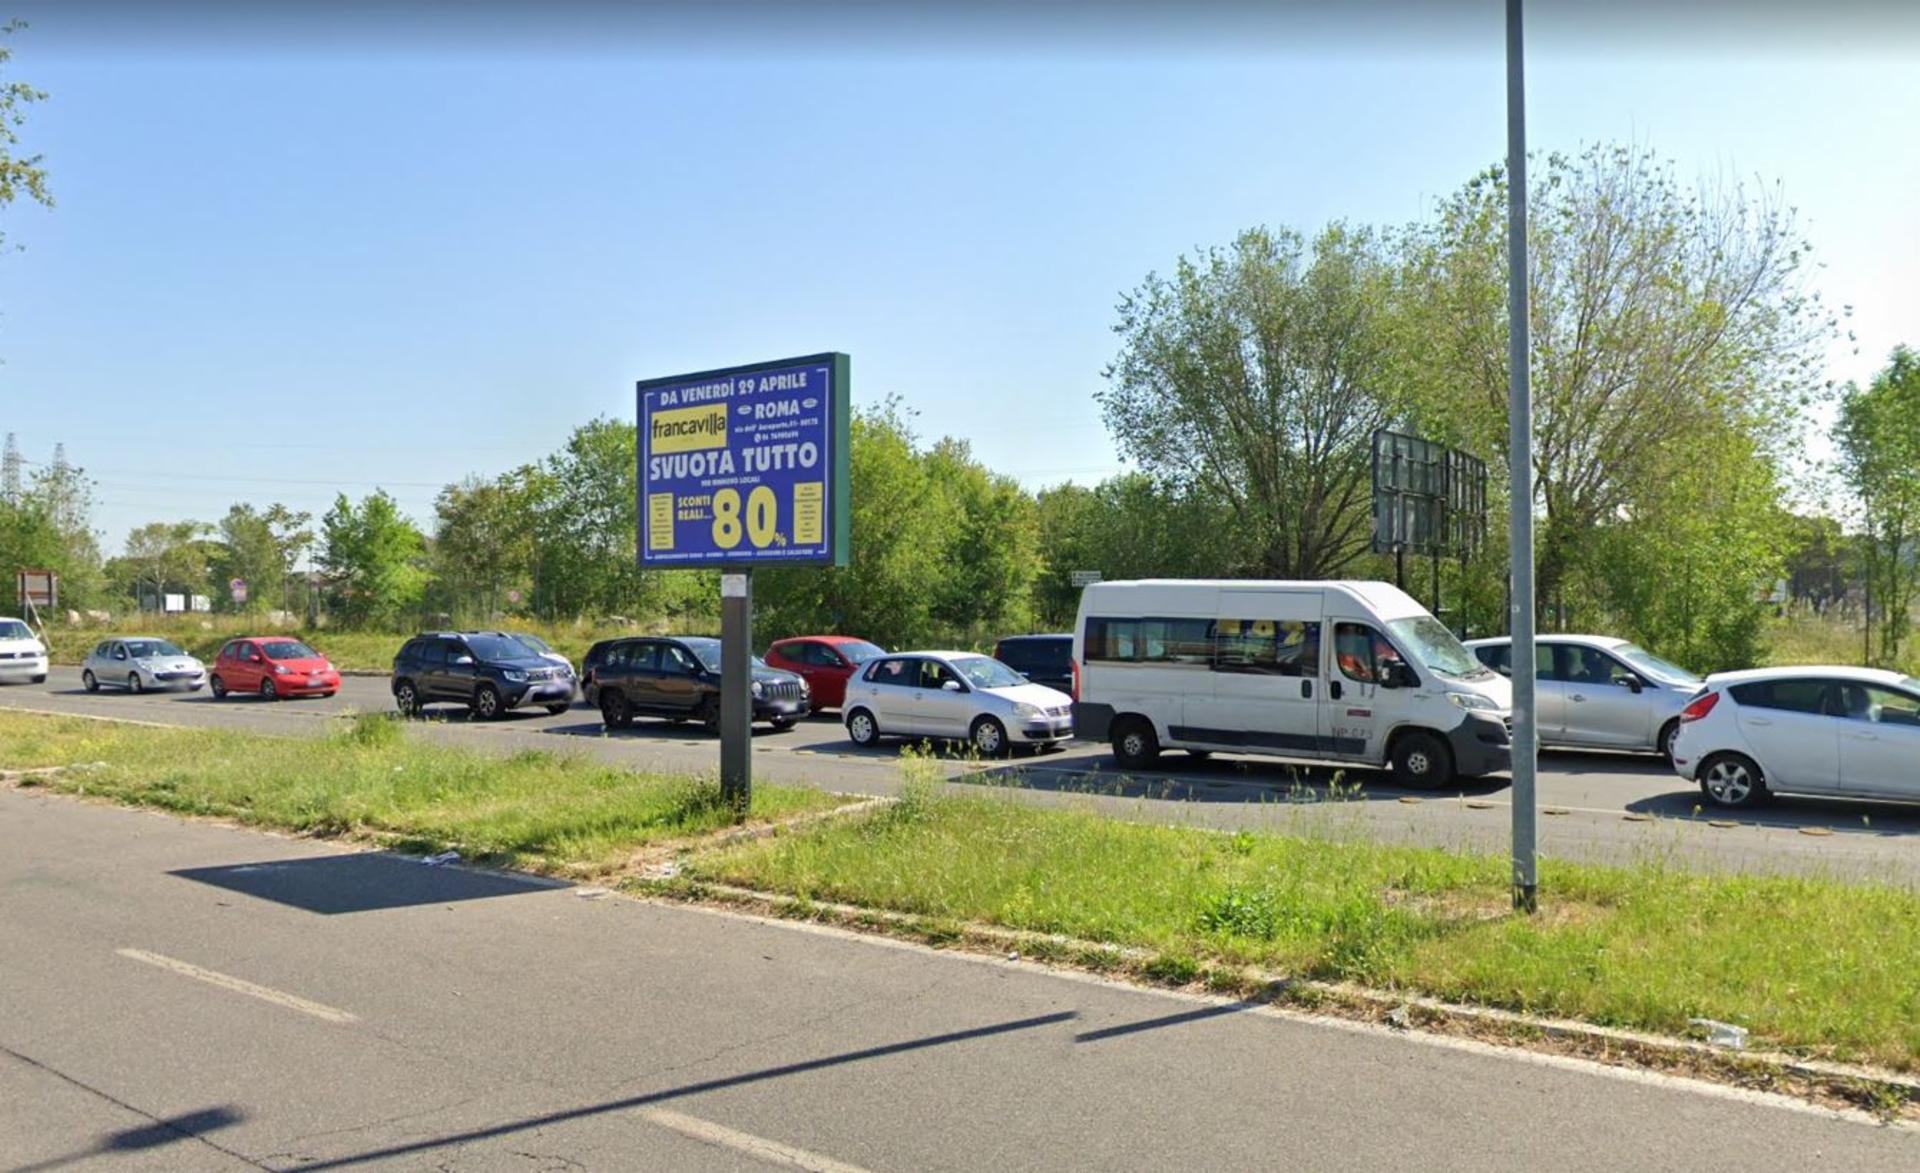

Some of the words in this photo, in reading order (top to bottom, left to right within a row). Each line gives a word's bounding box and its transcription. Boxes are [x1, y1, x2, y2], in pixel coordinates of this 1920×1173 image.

[660, 392, 678, 406] DA
[681, 378, 734, 402] VENERDÌ
[738, 379, 755, 395] 29
[759, 372, 807, 393] APRILE
[754, 398, 800, 420] ROMA
[652, 412, 726, 440] francavilla
[649, 449, 735, 481] SVUOTA
[742, 441, 818, 472] TUTTO
[678, 495, 711, 508] SCONTI
